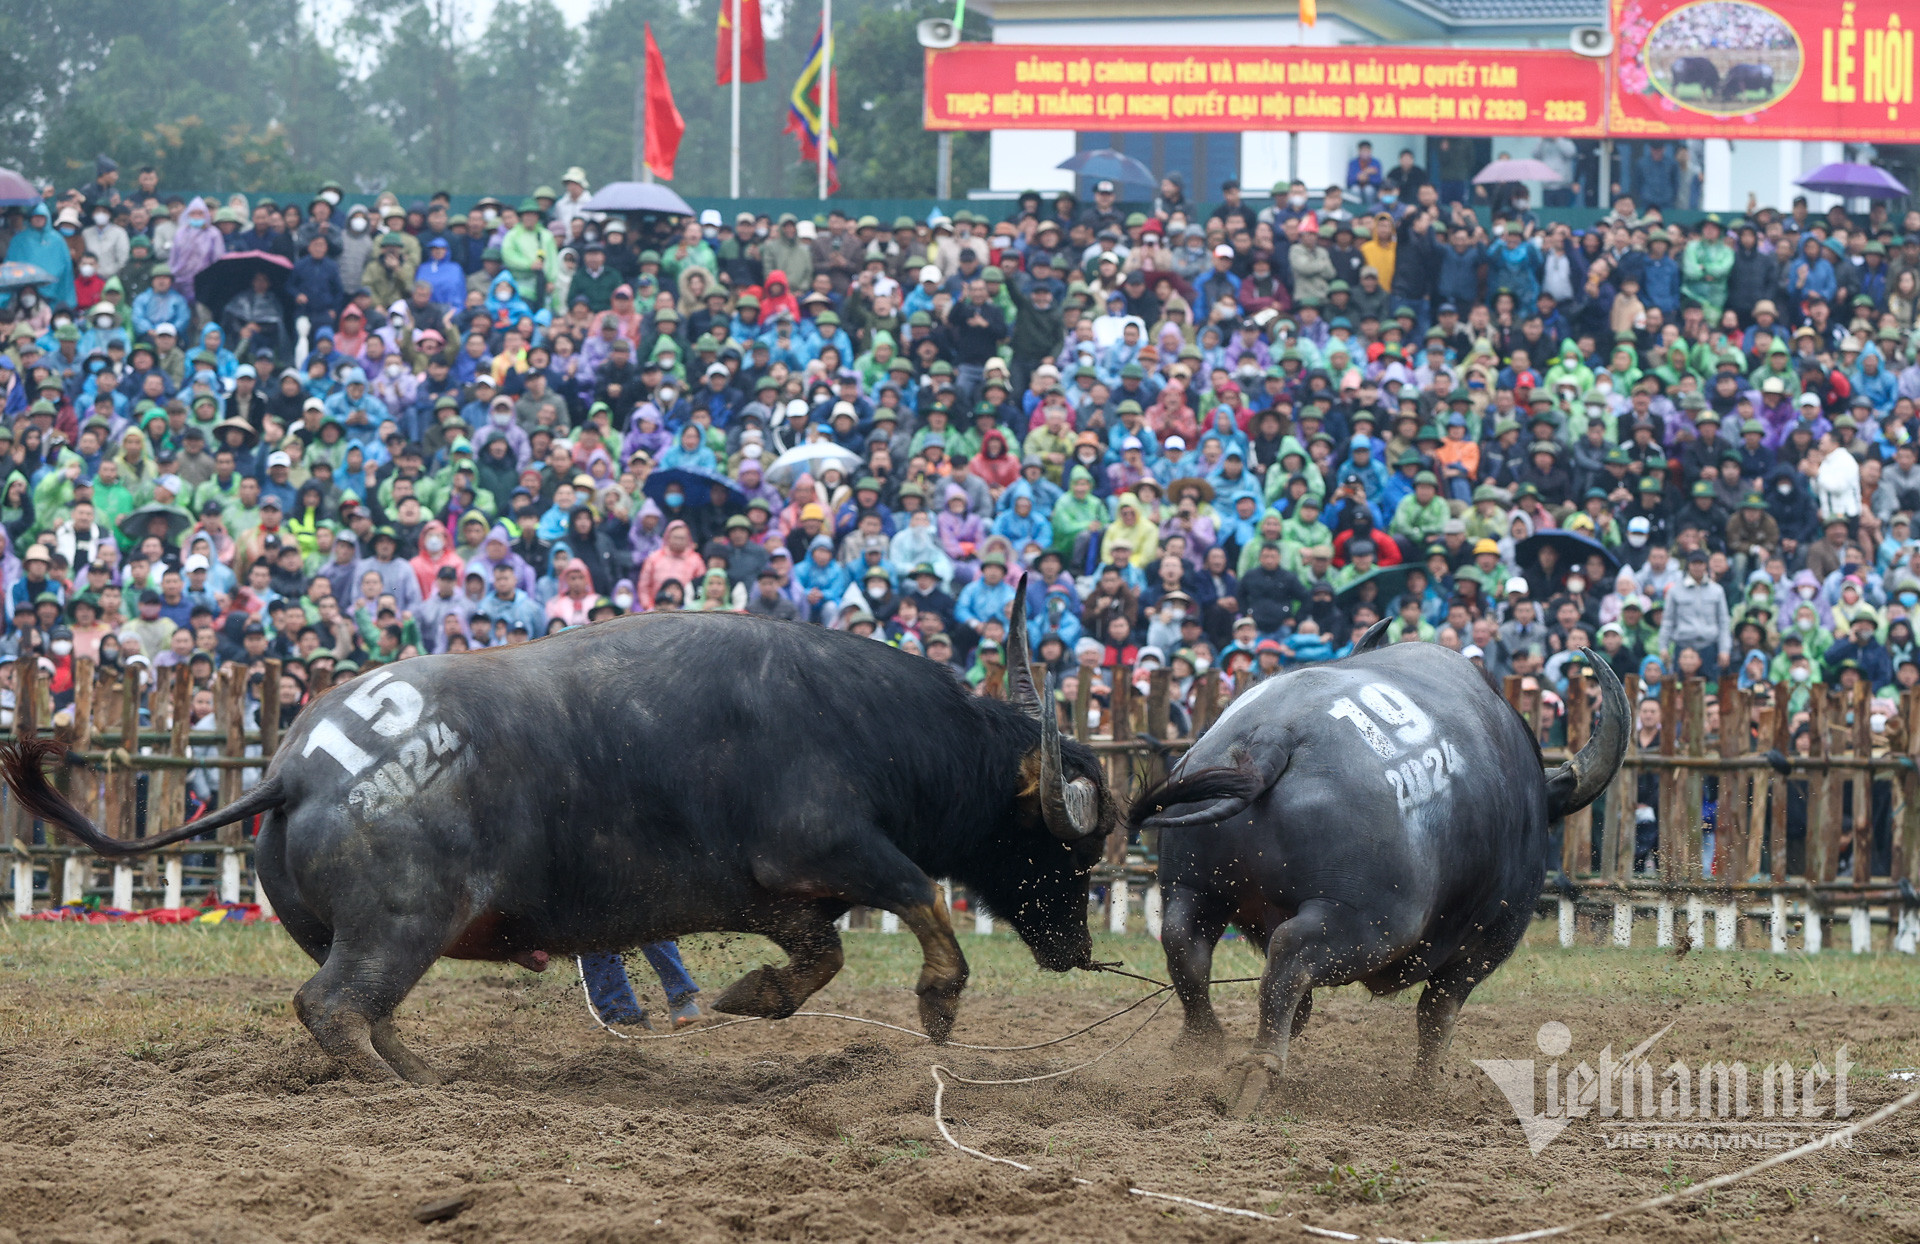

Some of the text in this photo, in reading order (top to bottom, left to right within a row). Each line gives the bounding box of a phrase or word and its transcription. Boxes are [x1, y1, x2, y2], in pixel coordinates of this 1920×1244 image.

[1822, 1, 1914, 121] LỄ HỘI
[301, 671, 424, 776] 15
[348, 721, 462, 823] 2024
[1327, 682, 1432, 760] 19
[1385, 738, 1468, 808] 2024
